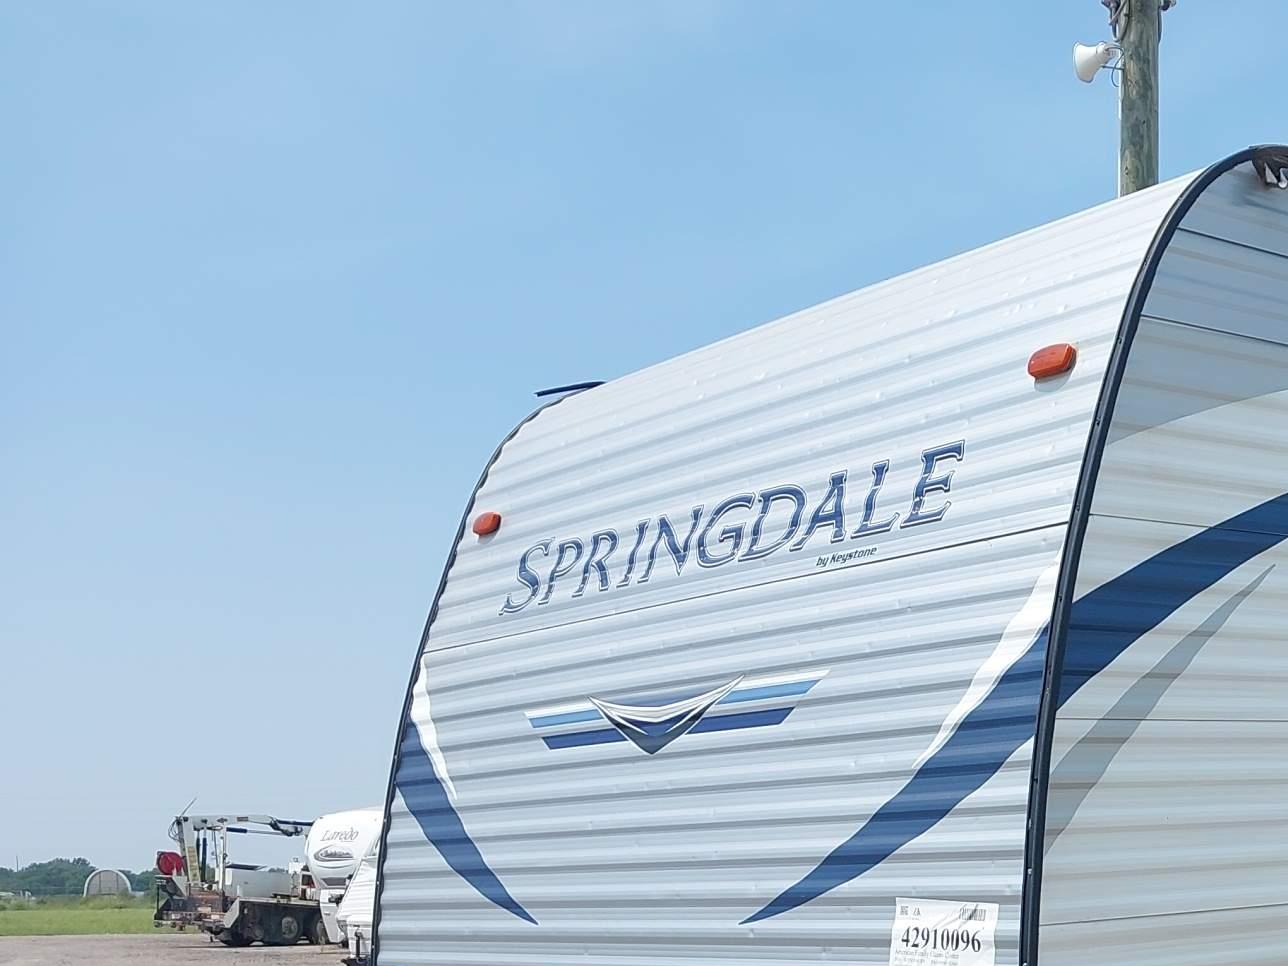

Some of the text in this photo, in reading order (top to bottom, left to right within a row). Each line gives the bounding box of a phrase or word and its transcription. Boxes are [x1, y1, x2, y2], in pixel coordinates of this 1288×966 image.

[499, 439, 966, 616] SPRINGDALE
[816, 547, 877, 567] by Keystone
[901, 926, 981, 952] 42910096
